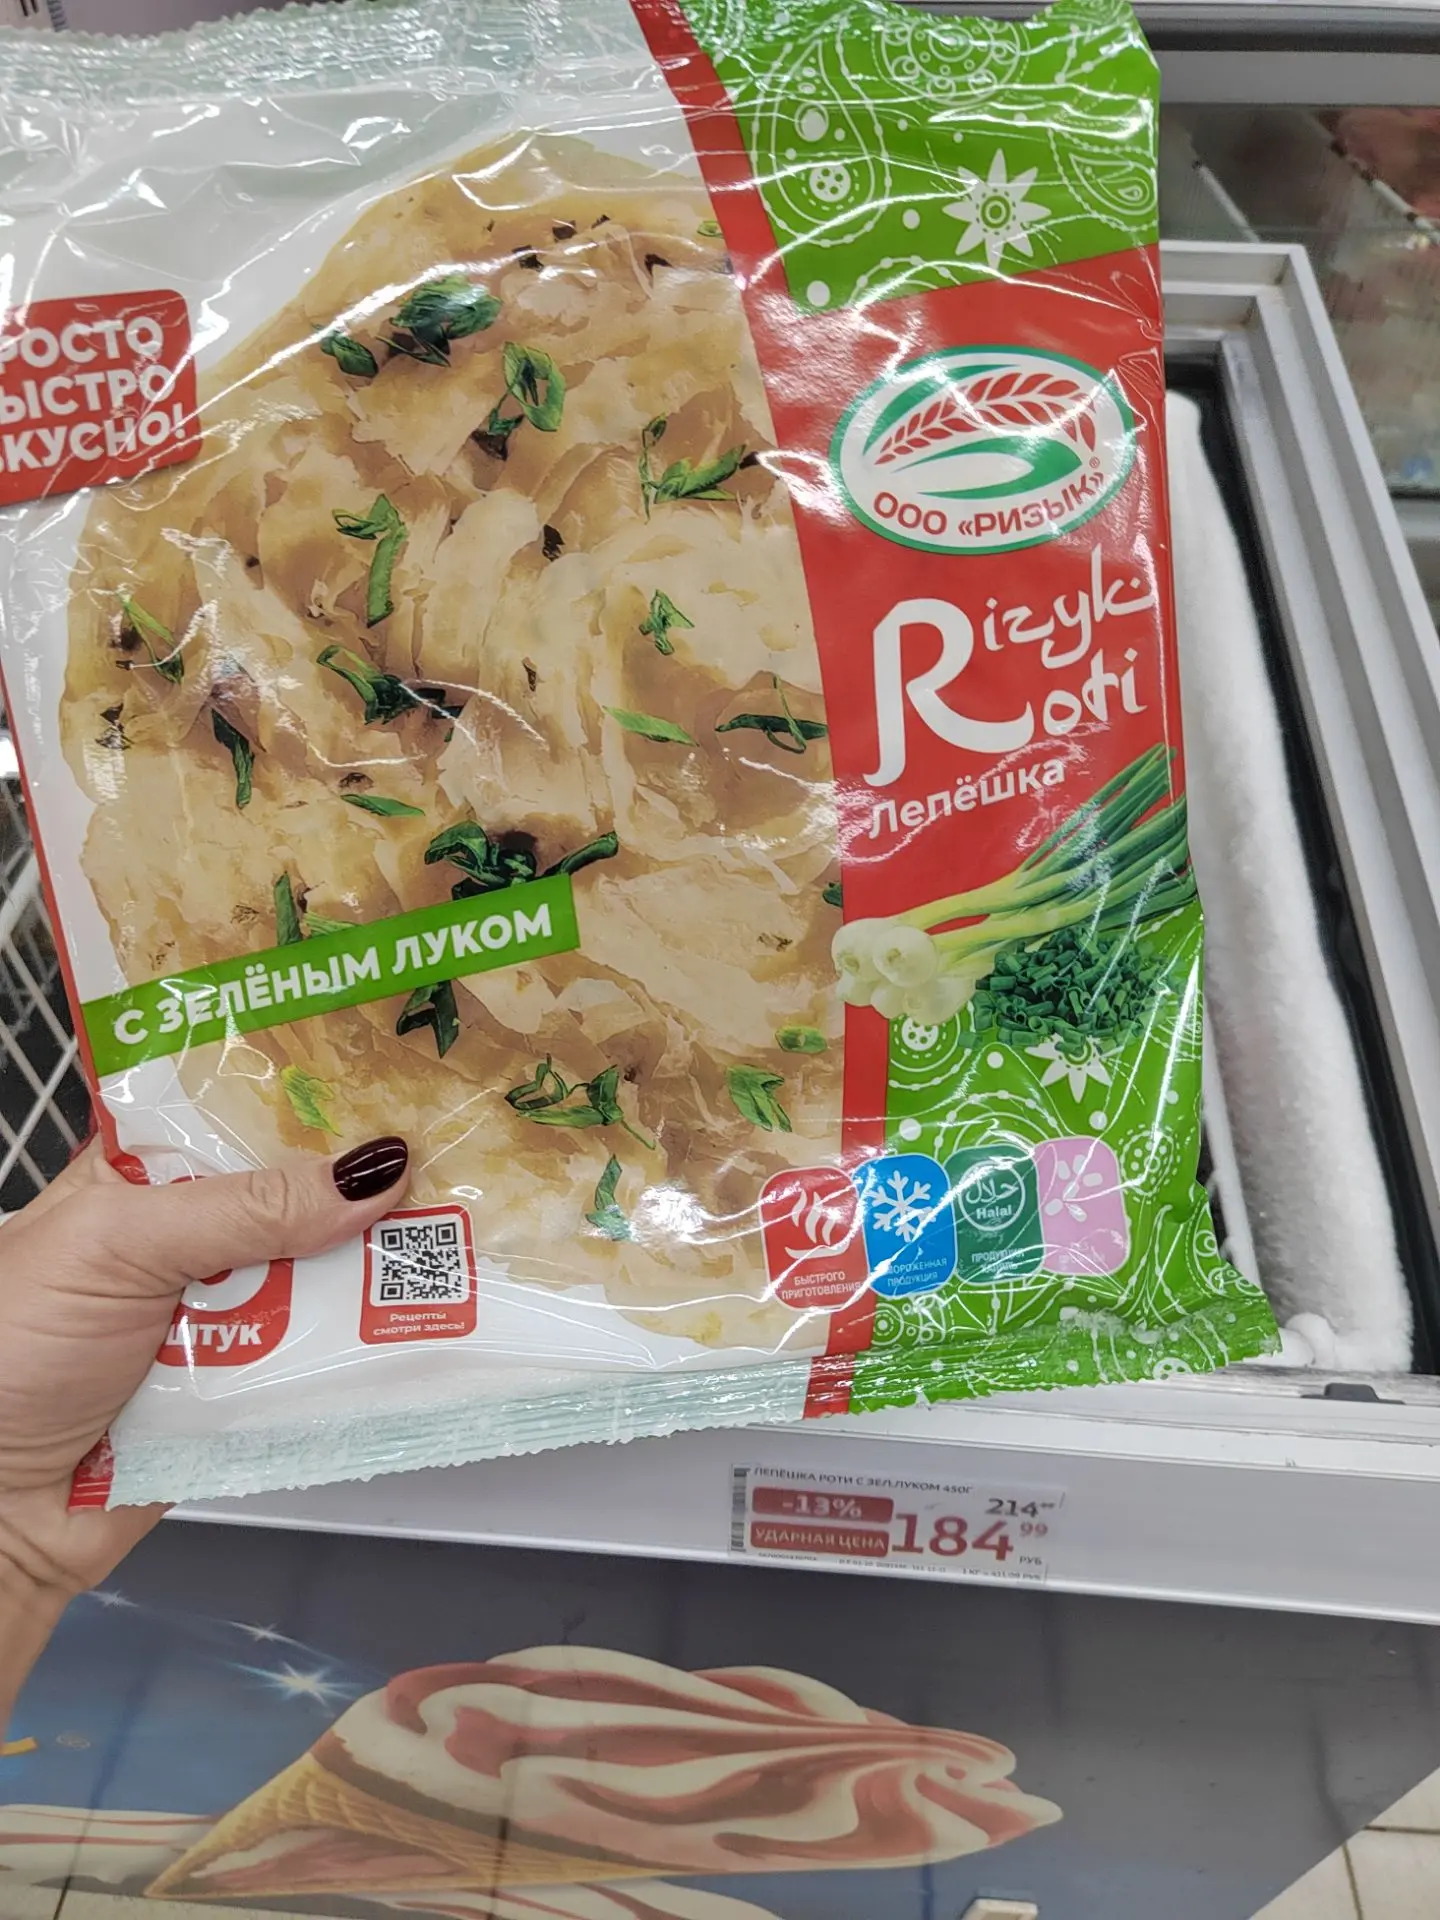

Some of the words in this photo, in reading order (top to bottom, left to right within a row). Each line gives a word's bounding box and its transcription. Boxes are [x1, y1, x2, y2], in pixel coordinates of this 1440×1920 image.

[0, 402, 186, 473] КУСНО!
[874, 492, 947, 535] ООО
[958, 472, 1104, 537] «РИЗЫК»
[868, 758, 1065, 839] Лепёшка
[158, 946, 381, 1033] ЗЕЛЁНЫМ
[392, 903, 553, 976] ЛУКОМ
[976, 1204, 1013, 1219] Halal
[794, 1271, 846, 1286] БЫСТРОГО
[887, 1271, 938, 1287] ПРОДУКЦИЯ
[390, 1312, 447, 1322] Рецепты
[373, 1324, 422, 1336] смотри
[424, 1321, 465, 1332] здесь!
[818, 1474, 854, 1486] РОТИ
[782, 1494, 863, 1519] -13%
[891, 1513, 1014, 1562] 184
[1020, 1521, 1048, 1538] 99
[755, 1527, 835, 1546] УДАРНАЯ
[838, 1534, 886, 1550] ЦЕНА
[1019, 1554, 1042, 1566] РУБ
